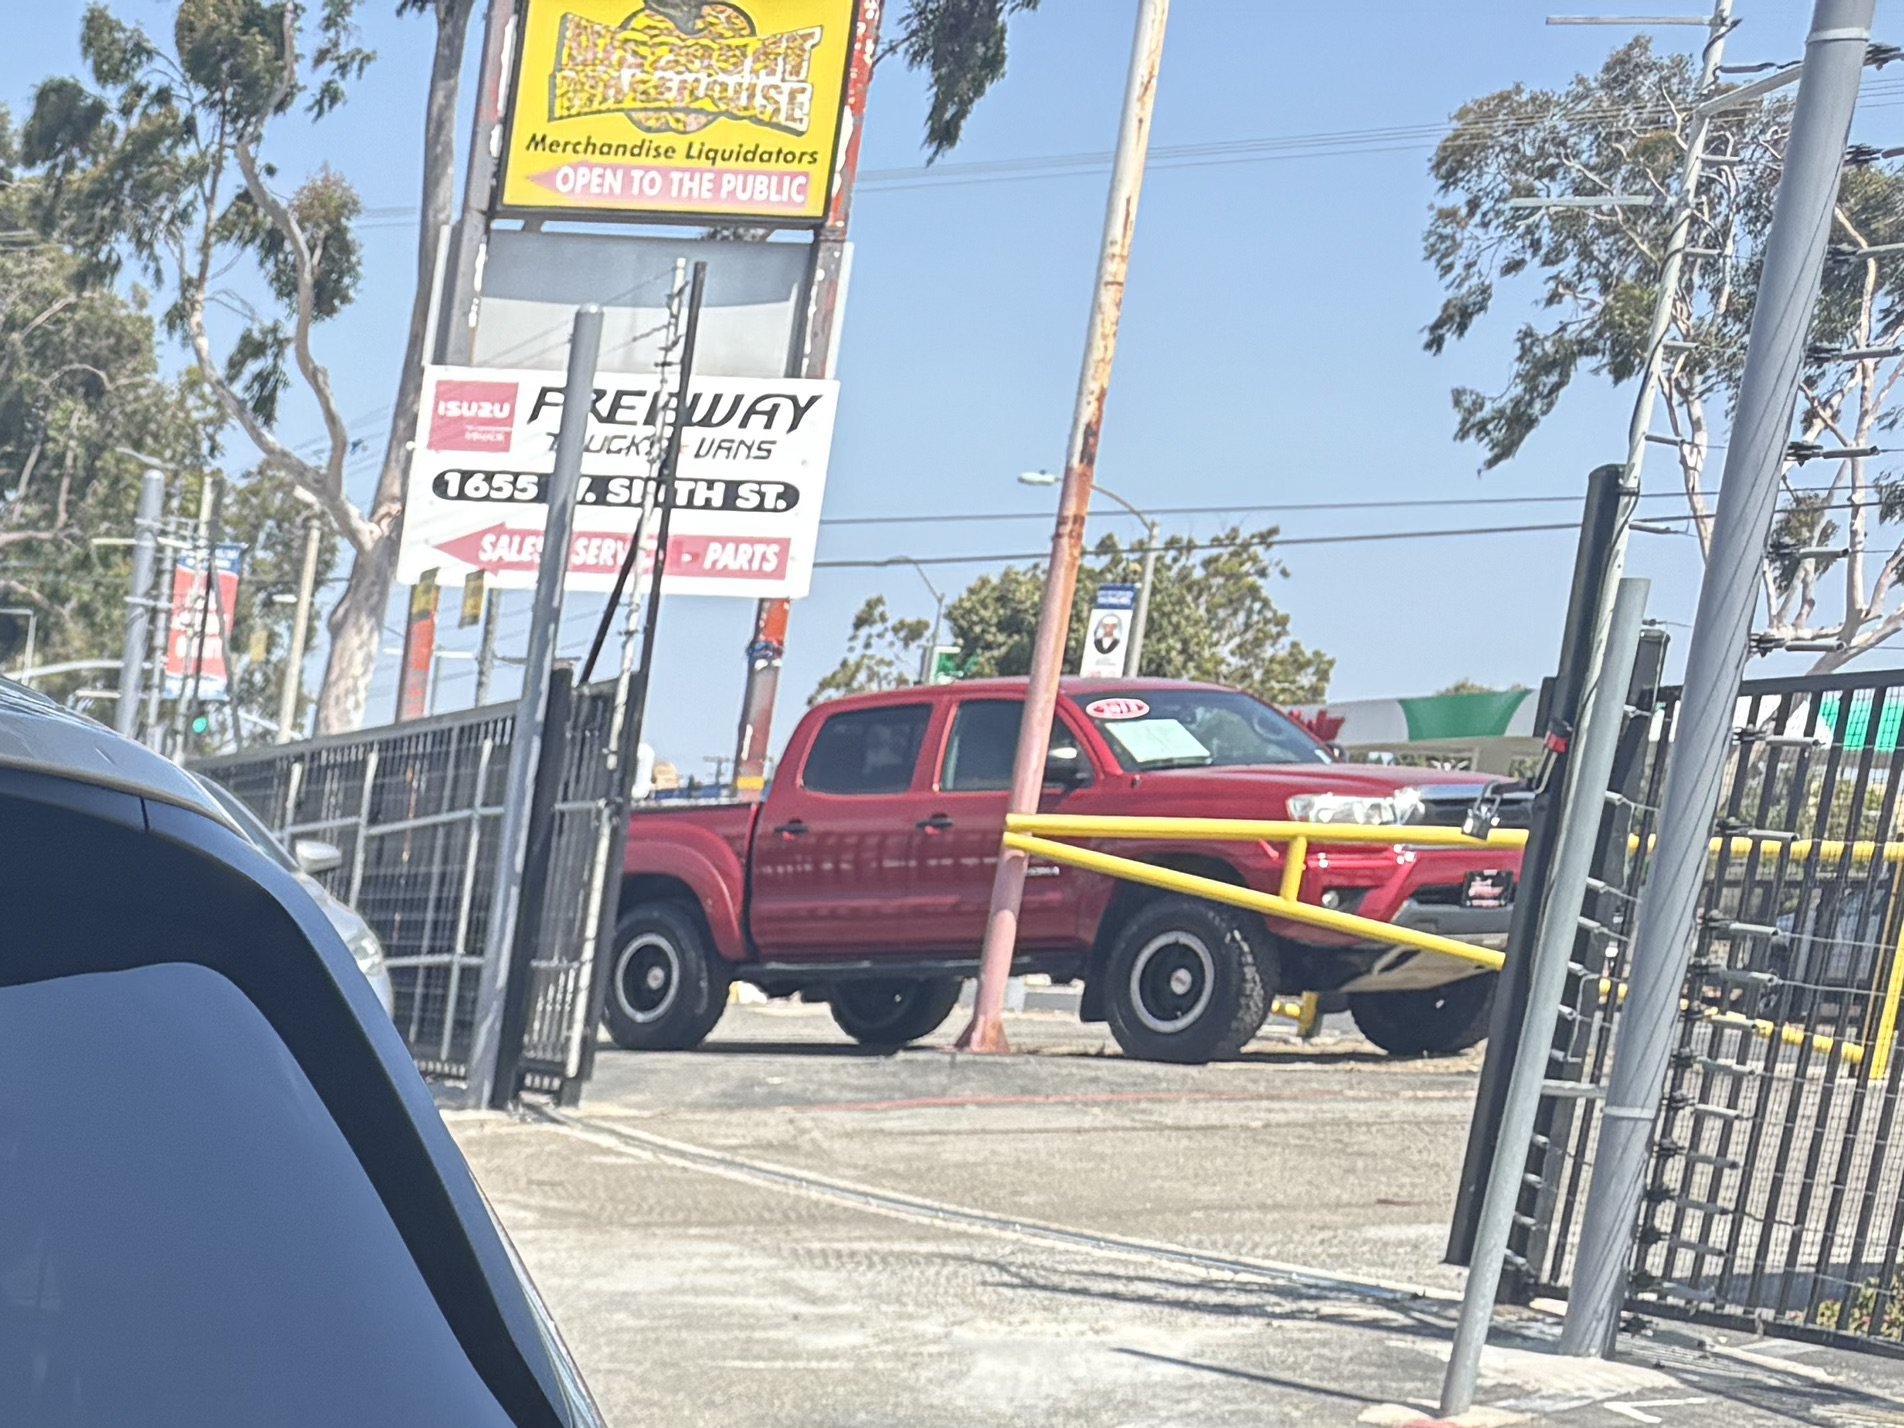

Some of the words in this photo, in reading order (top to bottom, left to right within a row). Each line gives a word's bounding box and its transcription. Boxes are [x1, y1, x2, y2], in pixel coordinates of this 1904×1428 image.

[526, 133, 676, 160] Merchandise
[685, 141, 819, 166] Liquidators
[555, 165, 623, 195] OPEN
[630, 168, 662, 197] TO
[669, 171, 713, 199] THE
[720, 172, 807, 202] PUBLIC
[437, 399, 511, 419] ISUZU
[694, 437, 777, 460] VANS
[444, 472, 539, 500] 1655
[606, 478, 726, 508] SITH
[735, 482, 788, 510] ST.
[703, 542, 781, 573] PARTS
